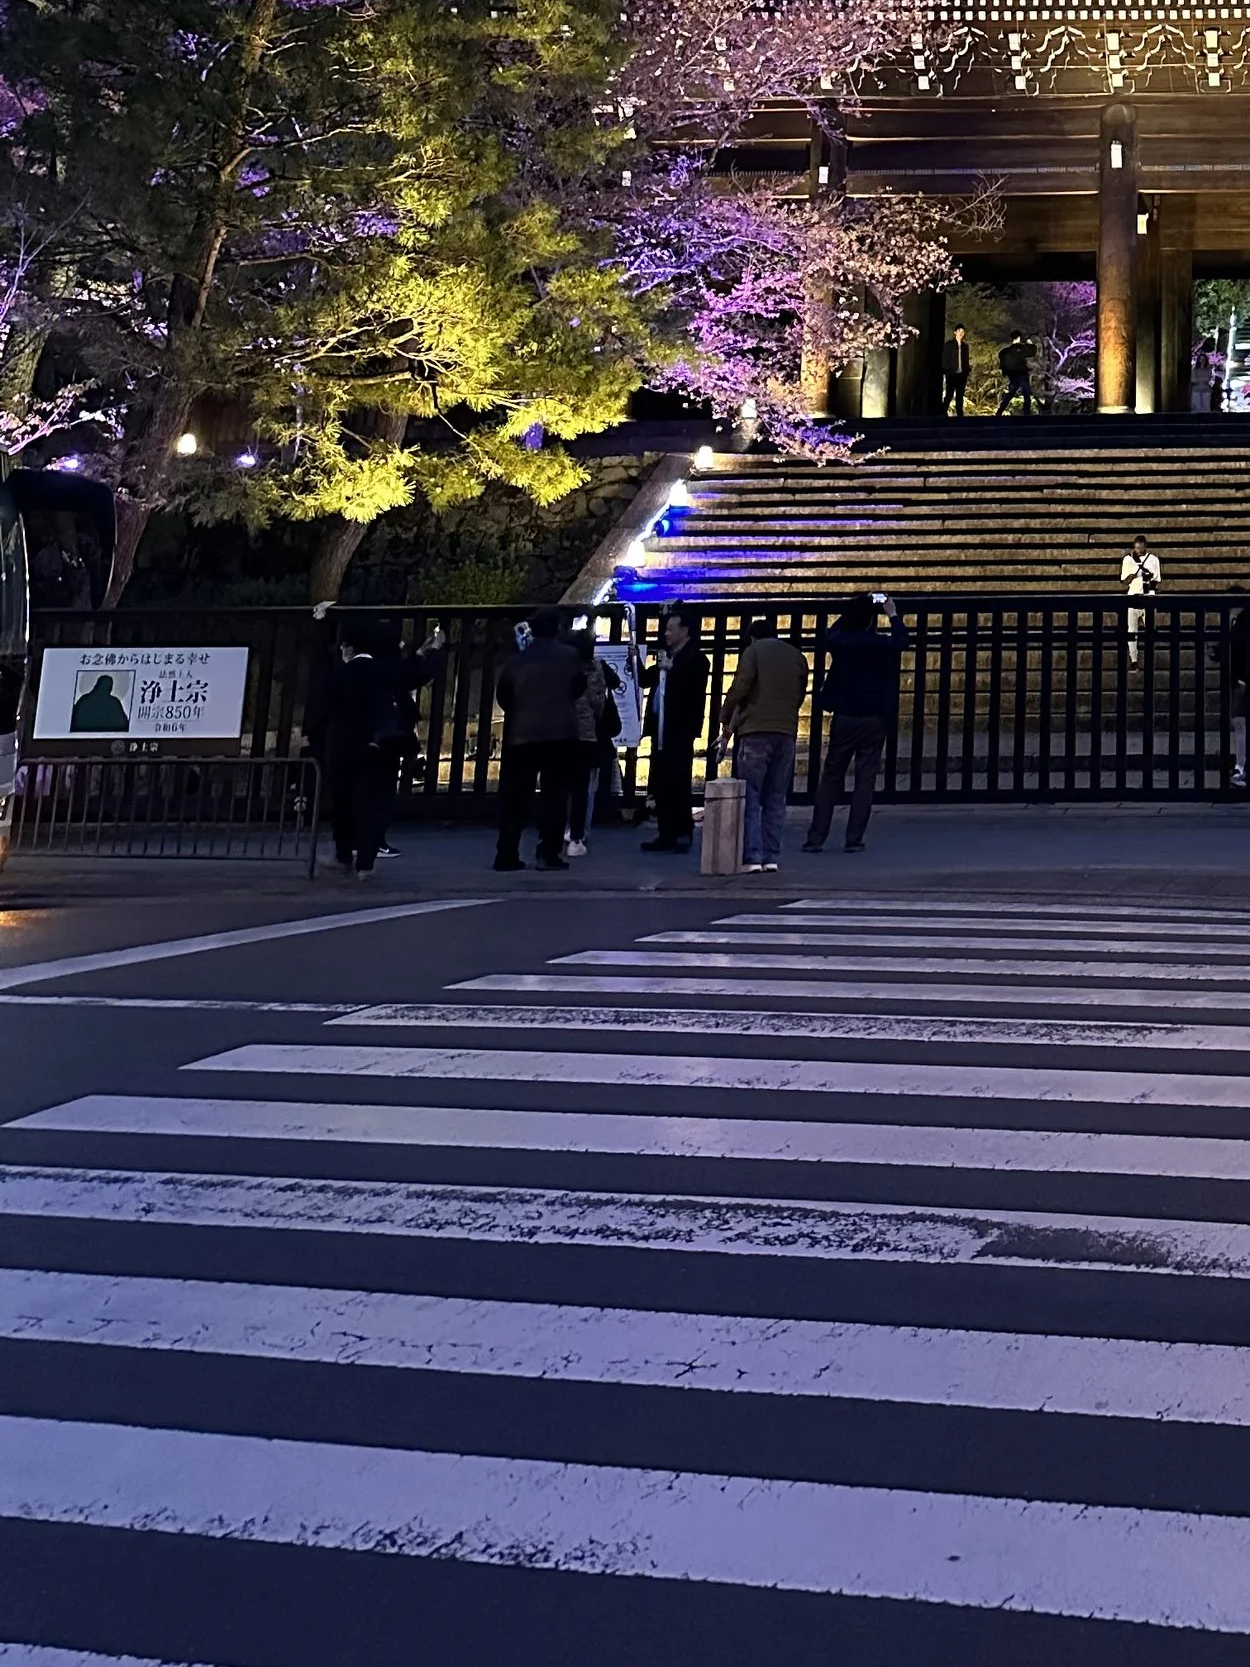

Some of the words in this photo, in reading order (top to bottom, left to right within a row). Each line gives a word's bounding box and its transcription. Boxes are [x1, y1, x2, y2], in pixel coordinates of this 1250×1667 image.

[79, 653, 210, 666] お念佛からはじまる幸せ
[140, 679, 209, 704] 浄土宗
[137, 705, 205, 719] 開宗850年
